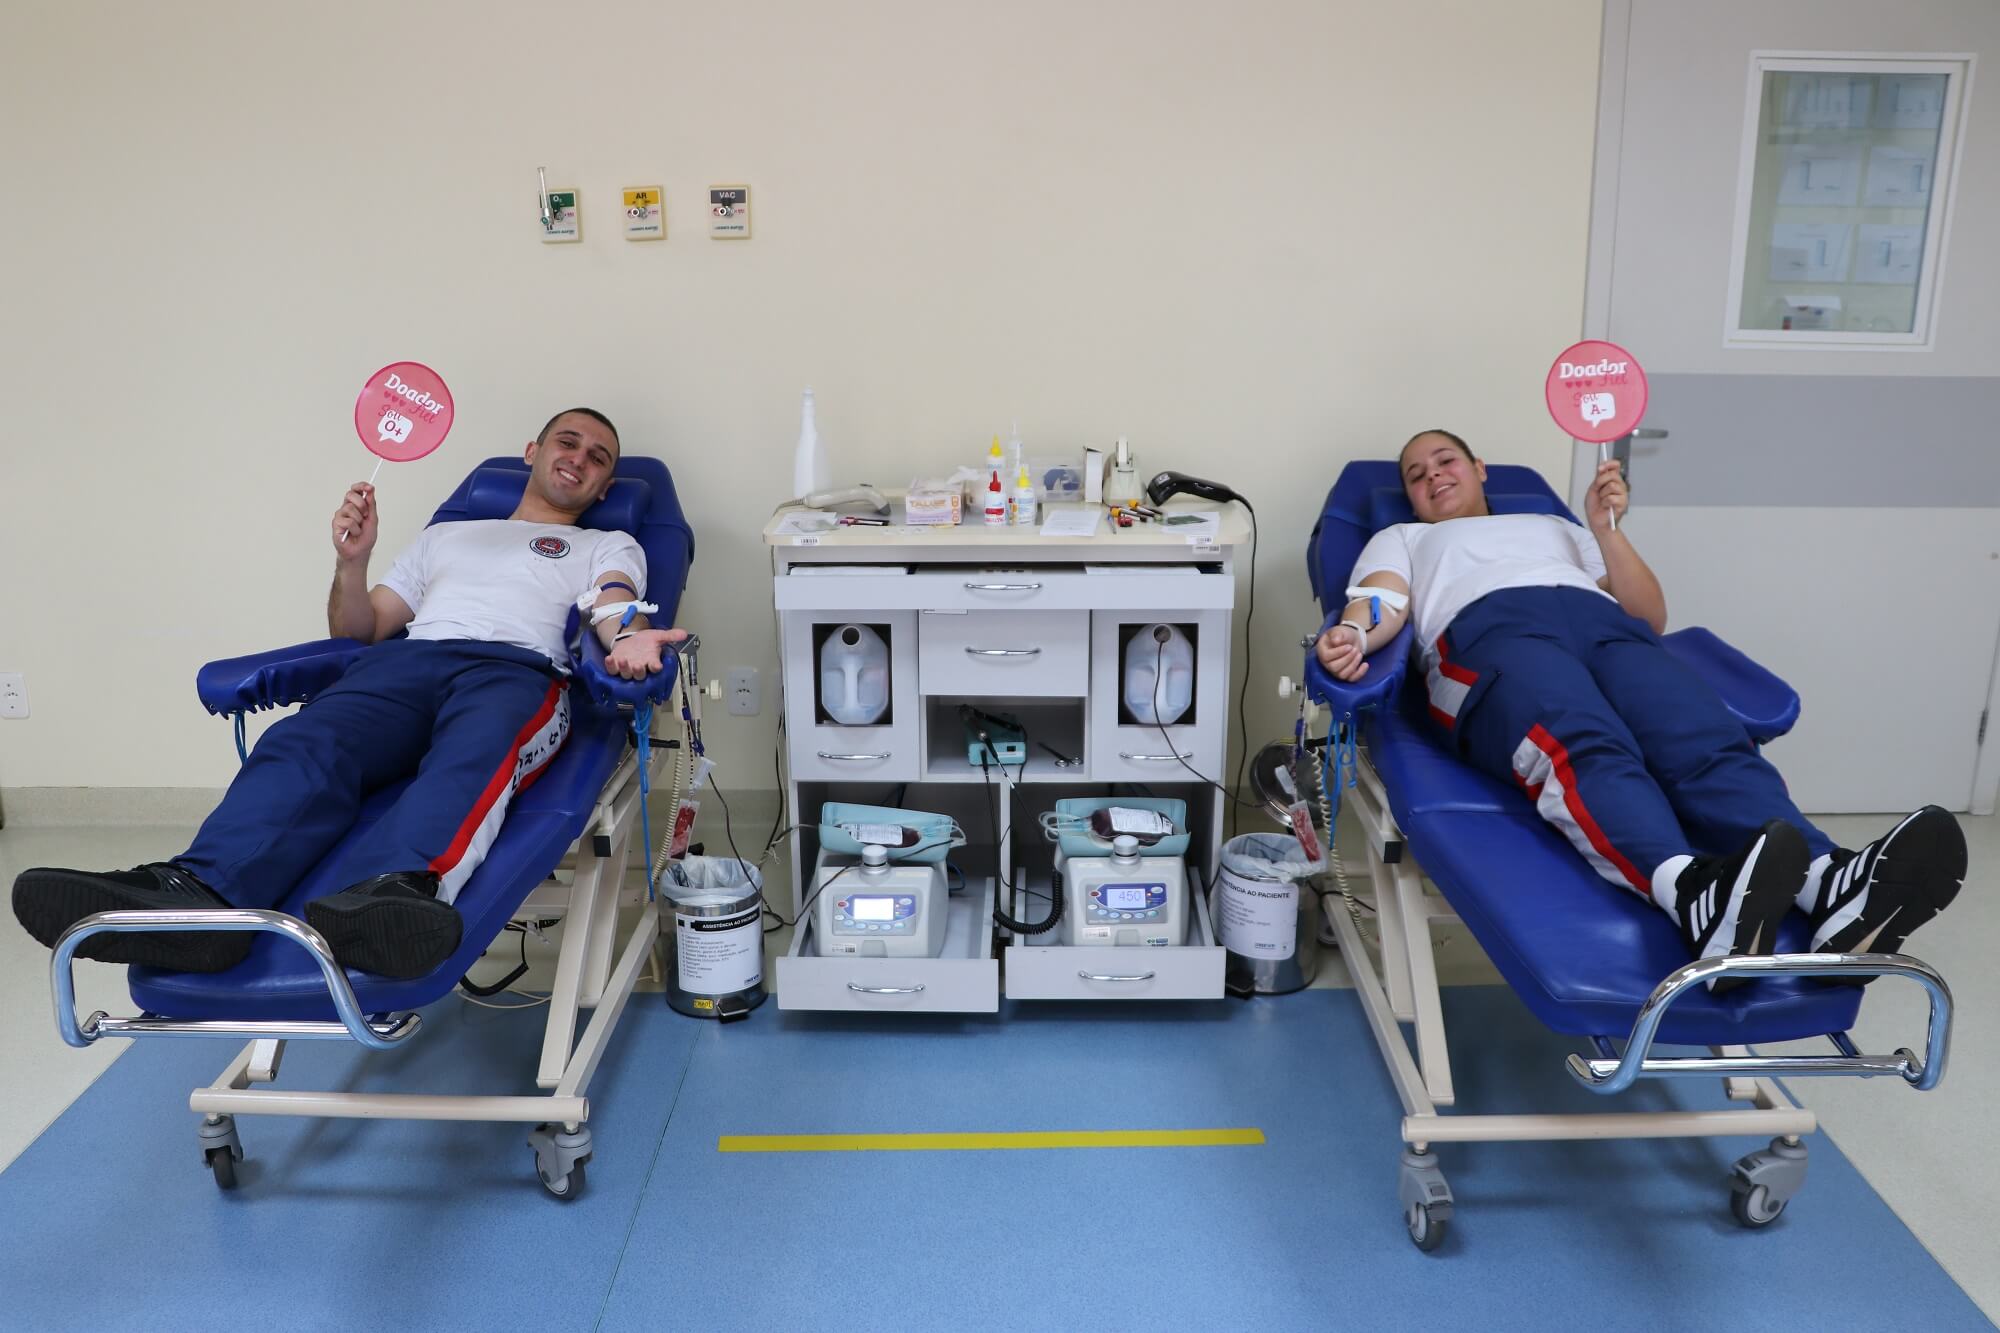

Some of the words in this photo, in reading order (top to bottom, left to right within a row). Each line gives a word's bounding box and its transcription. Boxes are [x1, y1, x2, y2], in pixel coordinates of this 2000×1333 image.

[719, 191, 736, 199] VAC
[1560, 358, 1627, 379] Doador
[384, 373, 444, 414] Doador
[378, 404, 401, 421] Sou
[1591, 404, 1607, 415] A-
[384, 420, 402, 436] O+
[1119, 889, 1141, 902] 450
[702, 920, 733, 929] ASSISTÊNCIA
